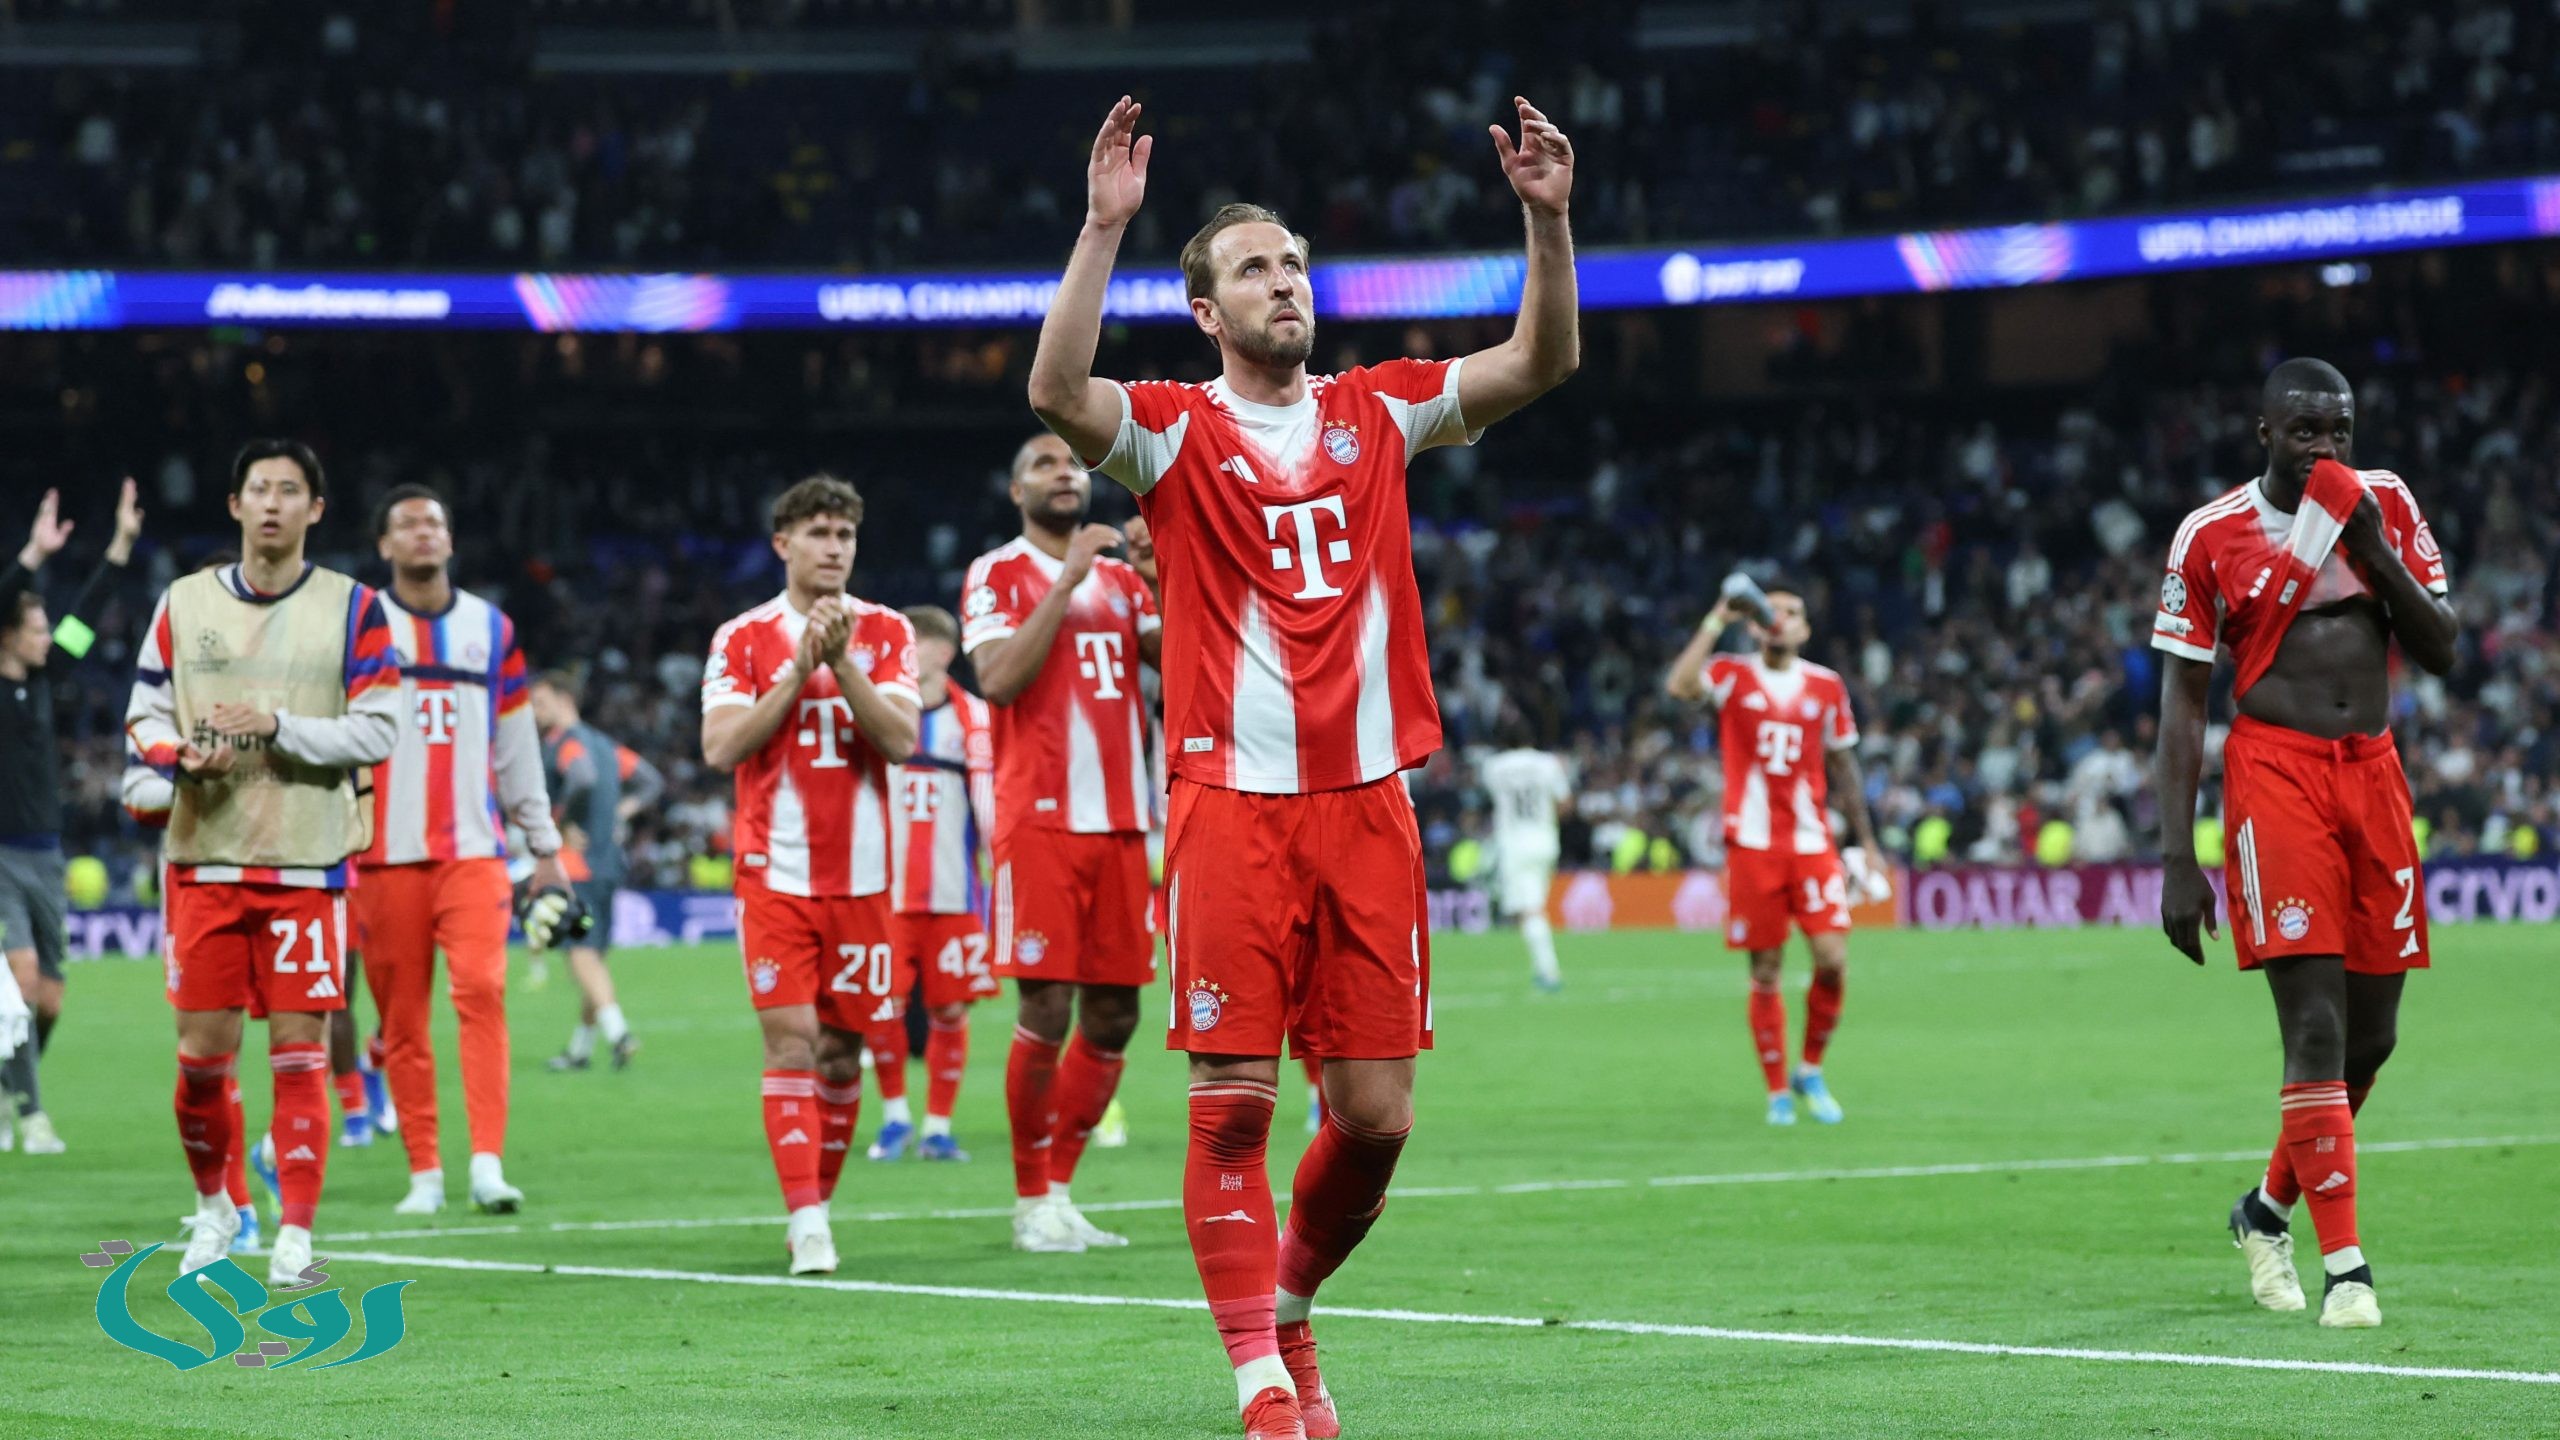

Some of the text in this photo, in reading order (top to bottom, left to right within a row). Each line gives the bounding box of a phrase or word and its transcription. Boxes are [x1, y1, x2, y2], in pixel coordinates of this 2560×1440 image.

[1261, 494, 1352, 600] T
[1074, 631, 1125, 700] T
[798, 696, 855, 769] T
[1757, 719, 1804, 776] T
[2393, 865, 2415, 930] 2
[269, 918, 332, 974] 21
[831, 942, 892, 996] 20
[937, 932, 991, 979] 42
